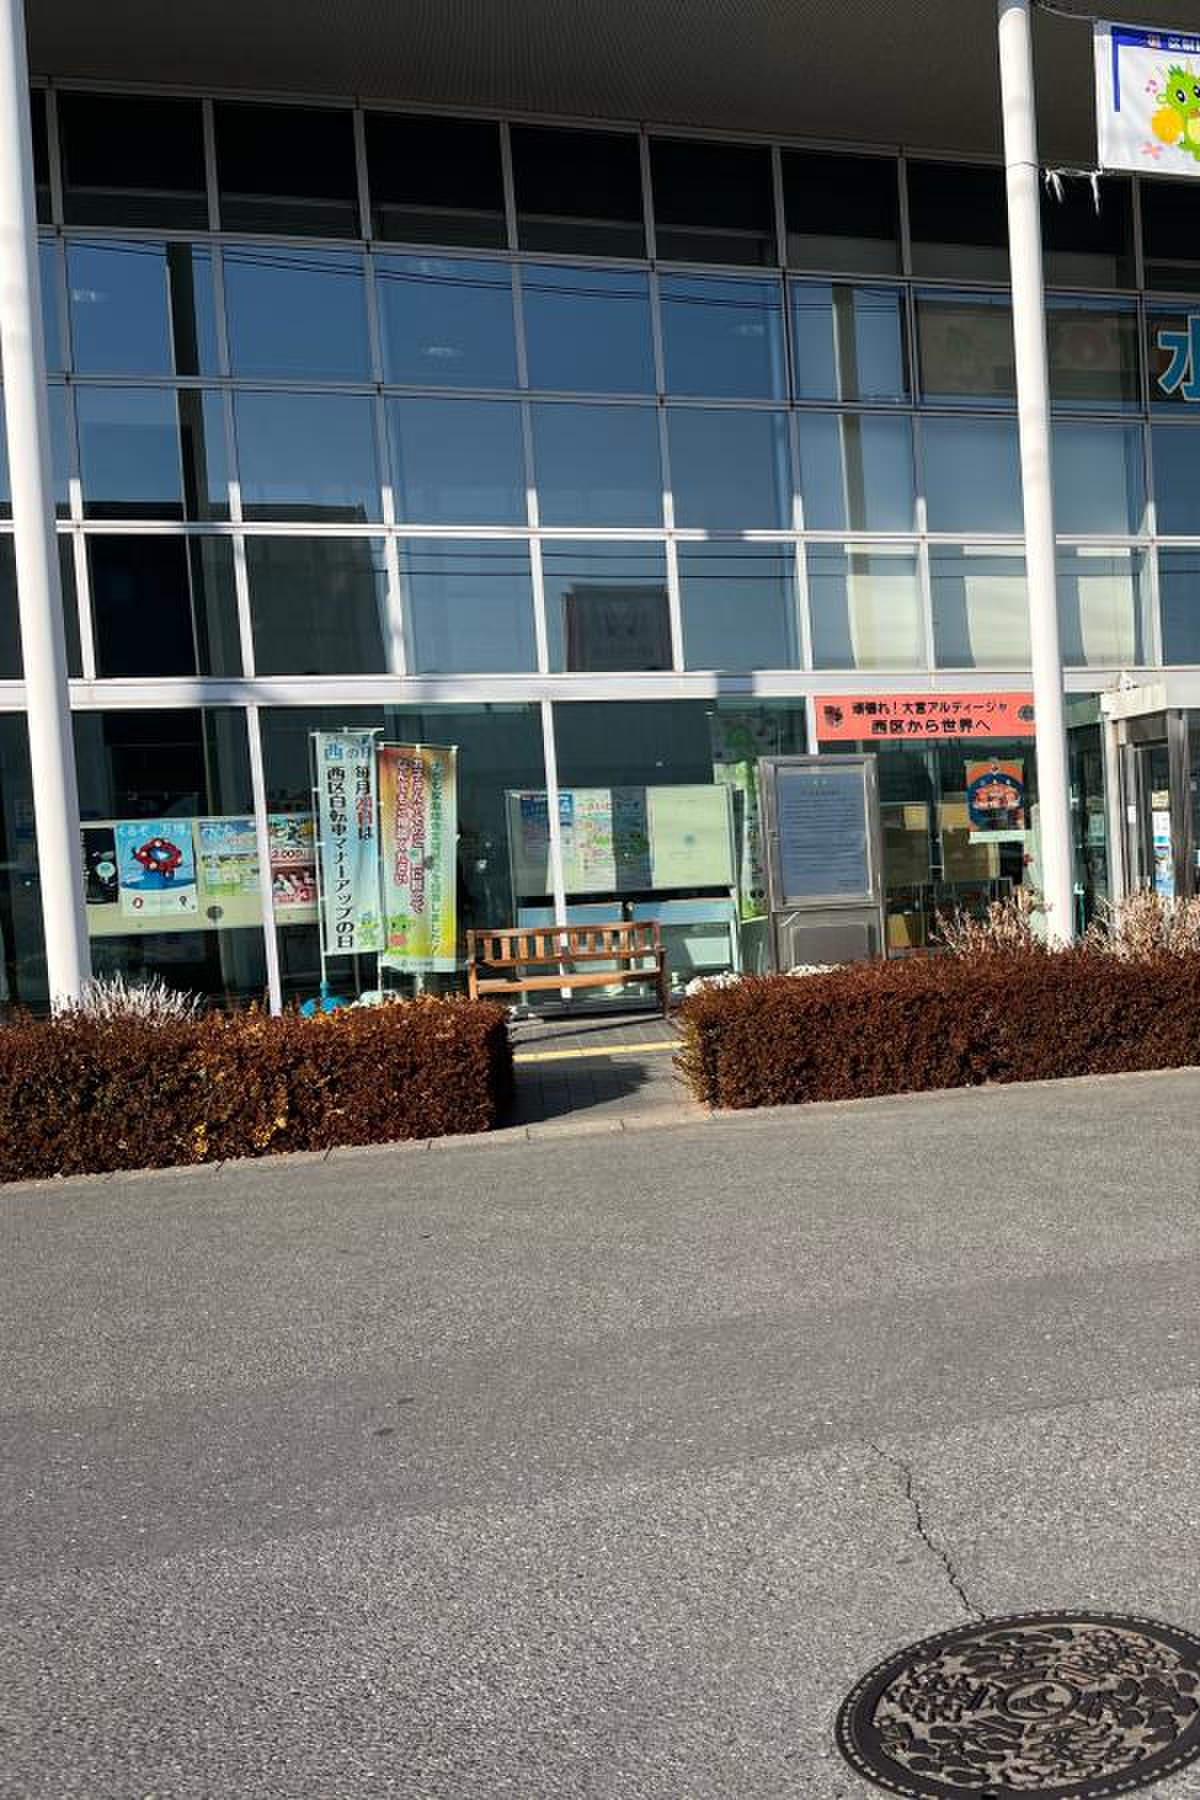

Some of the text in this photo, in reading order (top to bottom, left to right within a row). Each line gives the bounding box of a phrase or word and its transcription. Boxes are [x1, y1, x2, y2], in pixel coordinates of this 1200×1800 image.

[872, 718, 991, 735] 西区から世界へ
[327, 766, 354, 949] 西区自転車マナーアップの日
